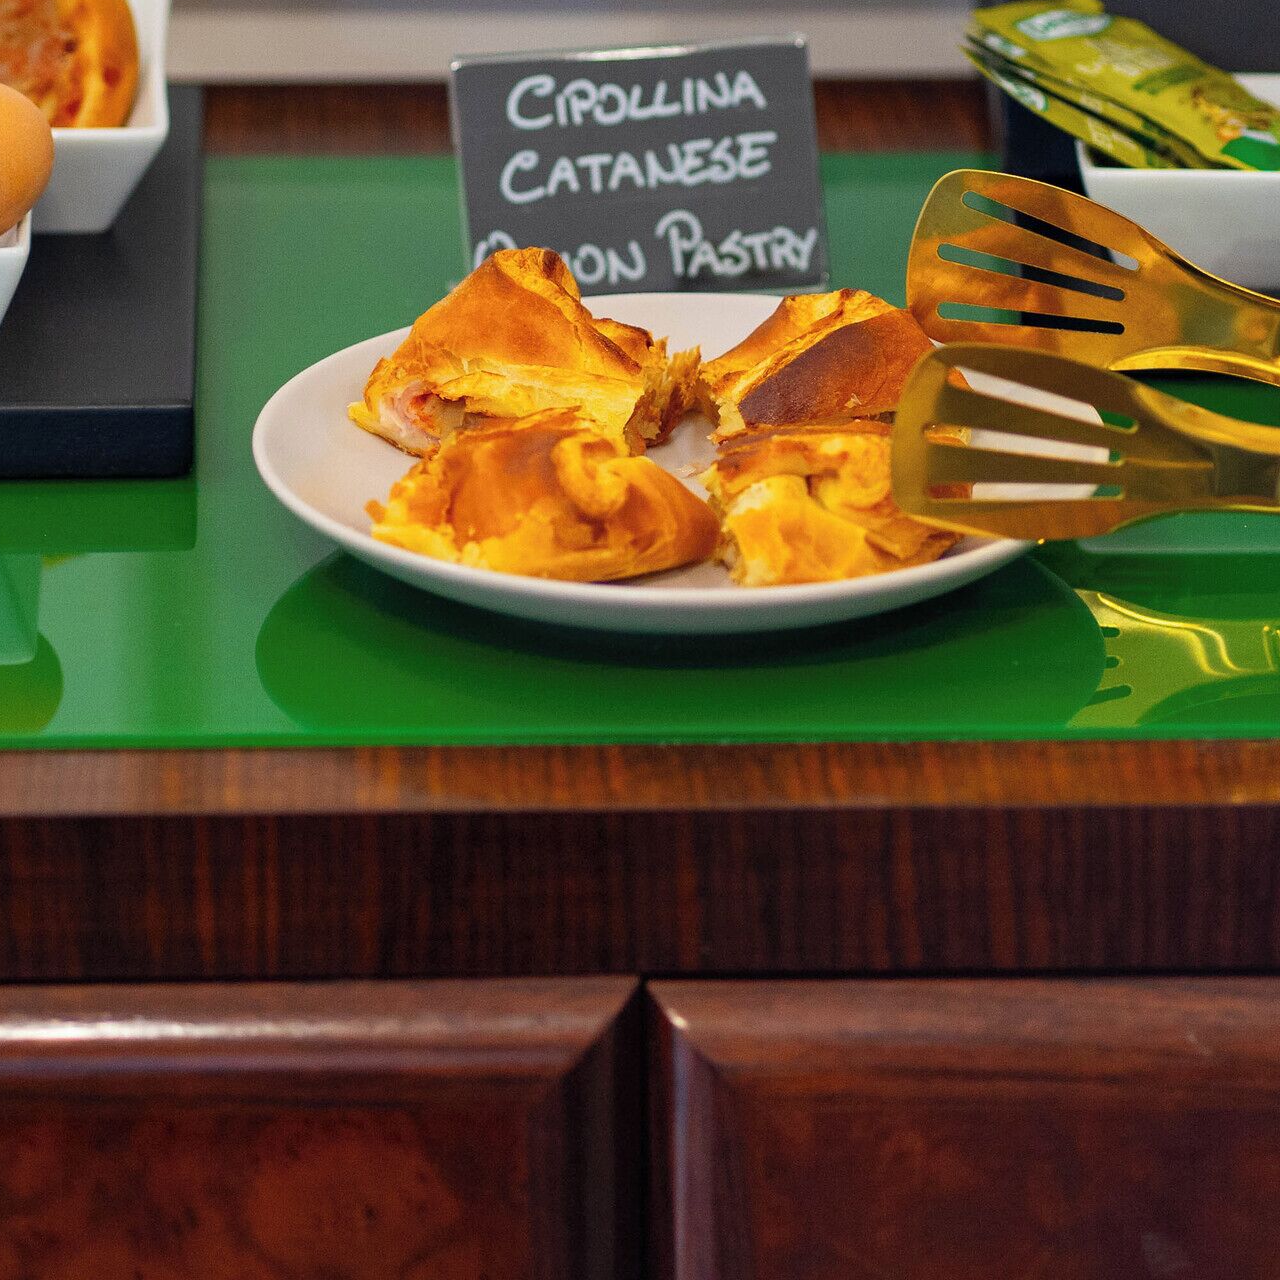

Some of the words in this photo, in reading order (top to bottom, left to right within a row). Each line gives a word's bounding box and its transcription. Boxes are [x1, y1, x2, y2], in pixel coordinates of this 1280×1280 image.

[506, 70, 768, 130] CIPOLLINA
[499, 131, 778, 204] CATANESE
[655, 209, 818, 278] PASTRY
